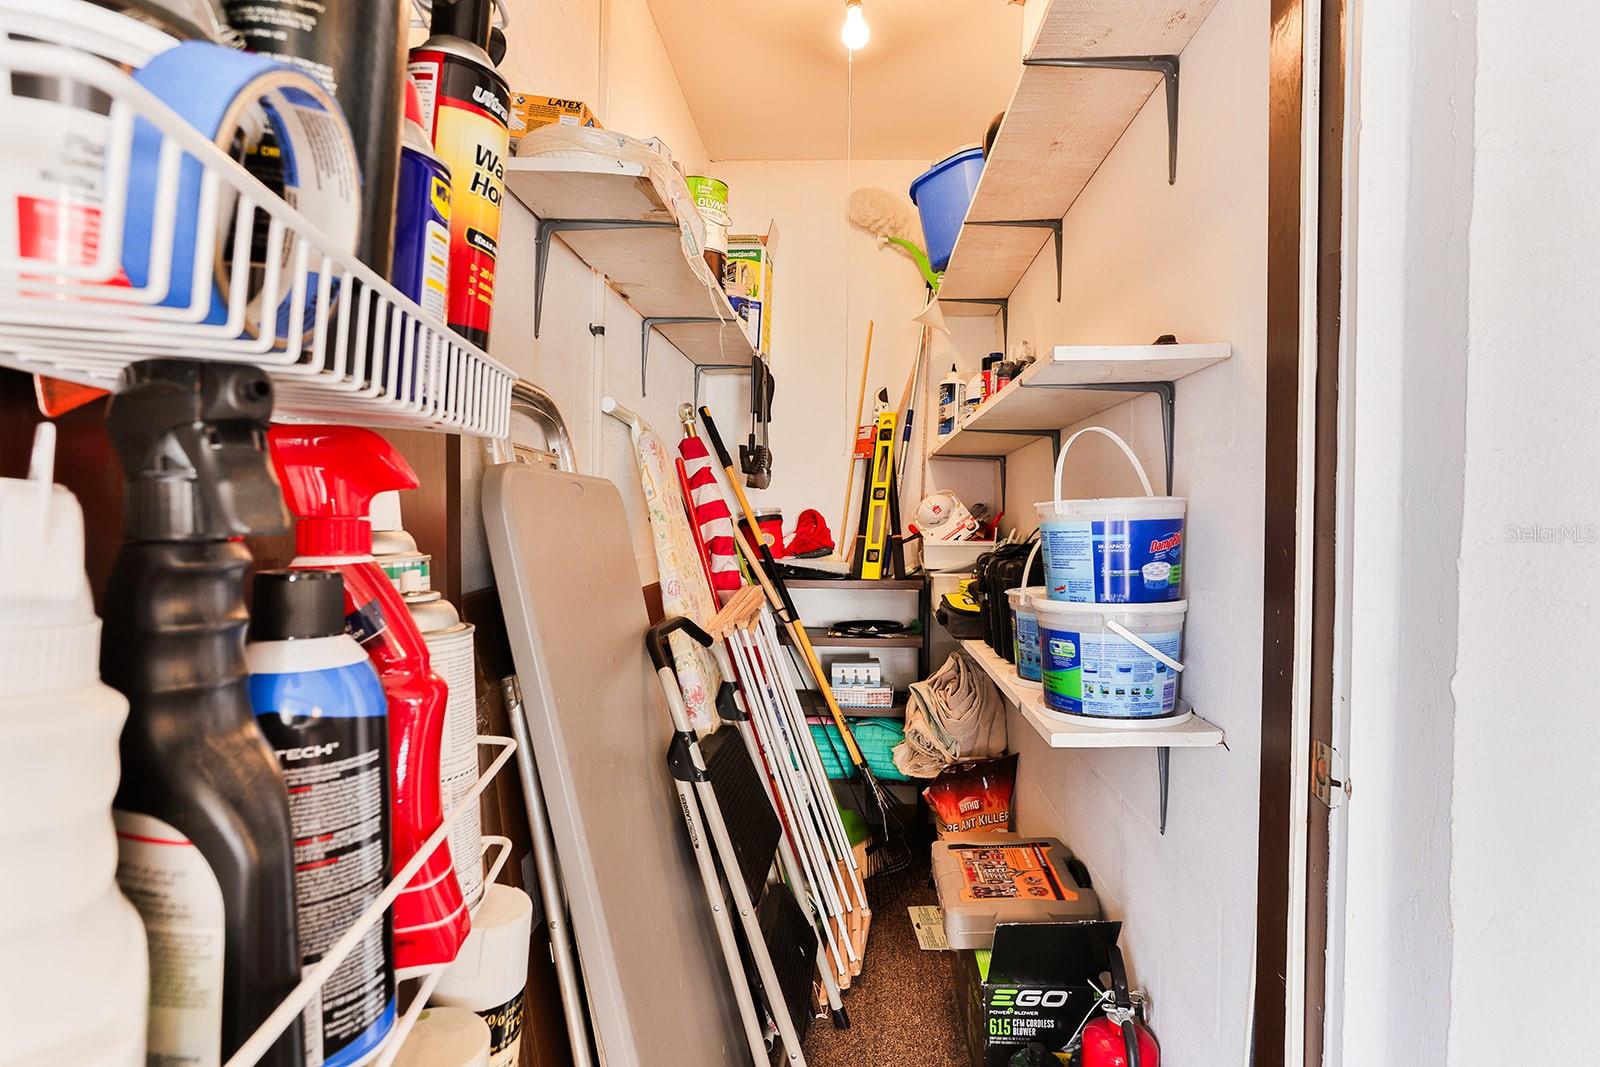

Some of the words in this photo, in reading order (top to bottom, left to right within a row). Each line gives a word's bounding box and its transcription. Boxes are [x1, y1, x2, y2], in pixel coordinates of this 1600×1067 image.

[547, 98, 583, 110] LATEX
[475, 143, 504, 181] Wa
[470, 171, 502, 207] Hor
[960, 799, 980, 813] ORTHO
[961, 817, 977, 832] ANT
[978, 811, 1010, 827] KILLER
[990, 989, 1069, 1008] EGO
[989, 1018, 1012, 1036] 615
[1012, 1018, 1026, 1028] CFM
[1026, 1019, 1055, 1029] CORDLESS
[1012, 1027, 1037, 1037] BLOWER
